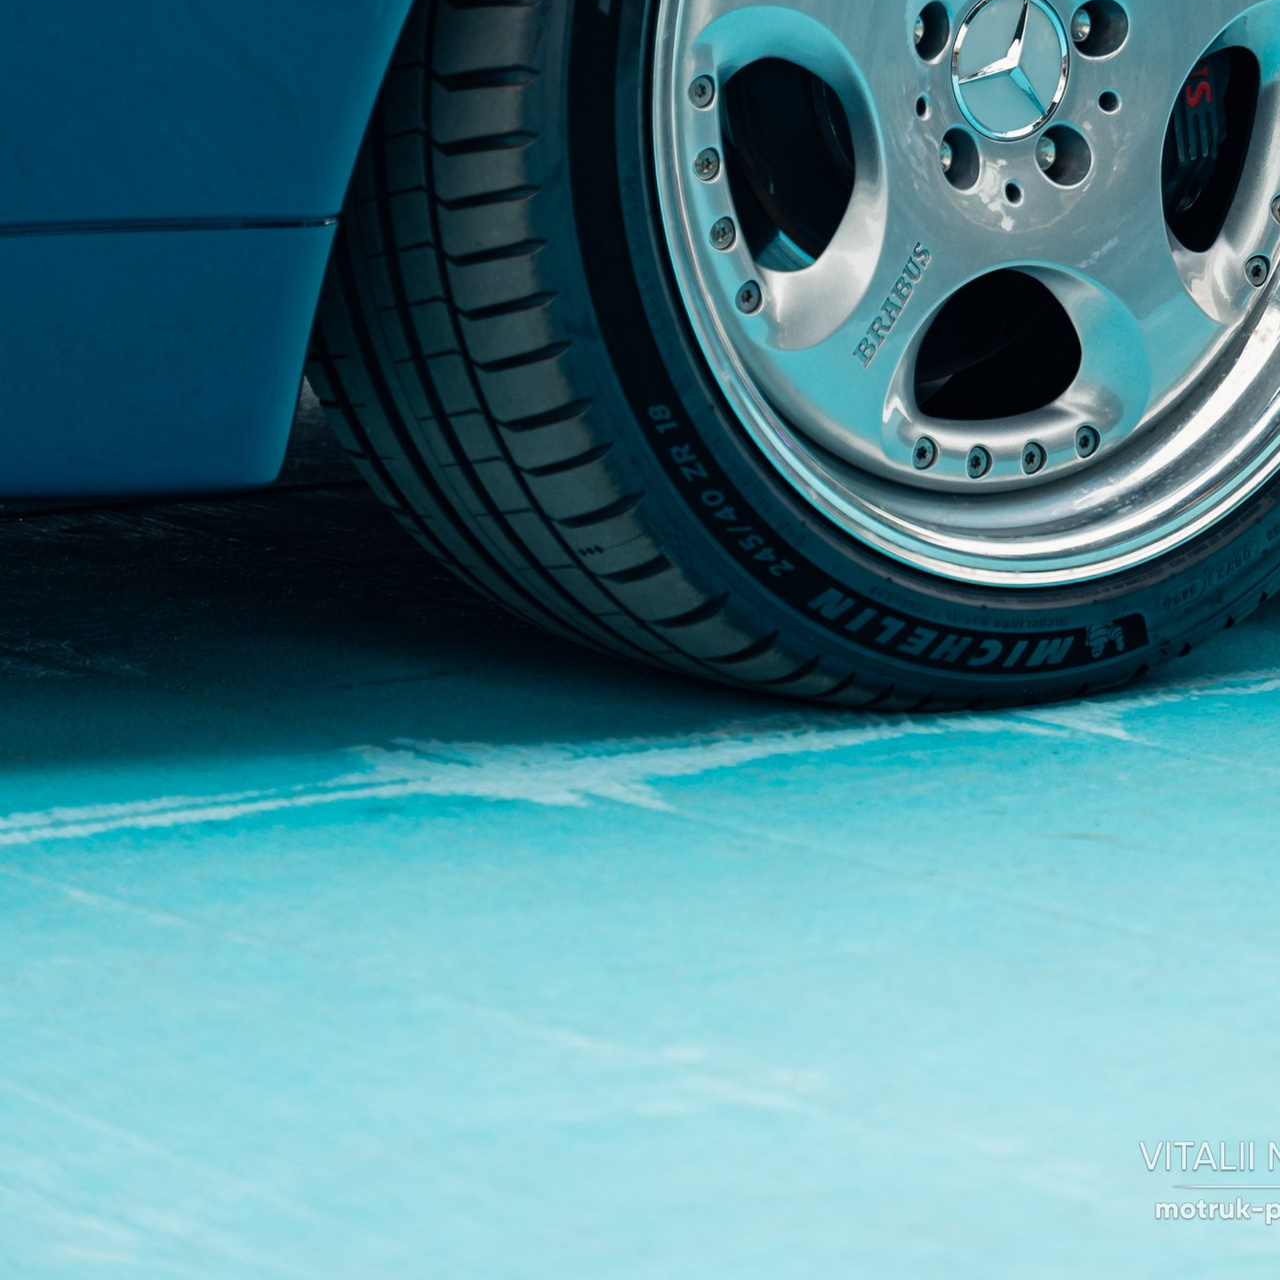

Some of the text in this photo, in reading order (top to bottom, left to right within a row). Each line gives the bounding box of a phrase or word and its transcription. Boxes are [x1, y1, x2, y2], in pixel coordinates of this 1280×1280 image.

[852, 241, 931, 368] BRABUS
[648, 404, 678, 434] 18
[670, 443, 709, 482] ZR
[701, 490, 795, 577] 245/40
[807, 587, 1075, 667] MICHELIN
